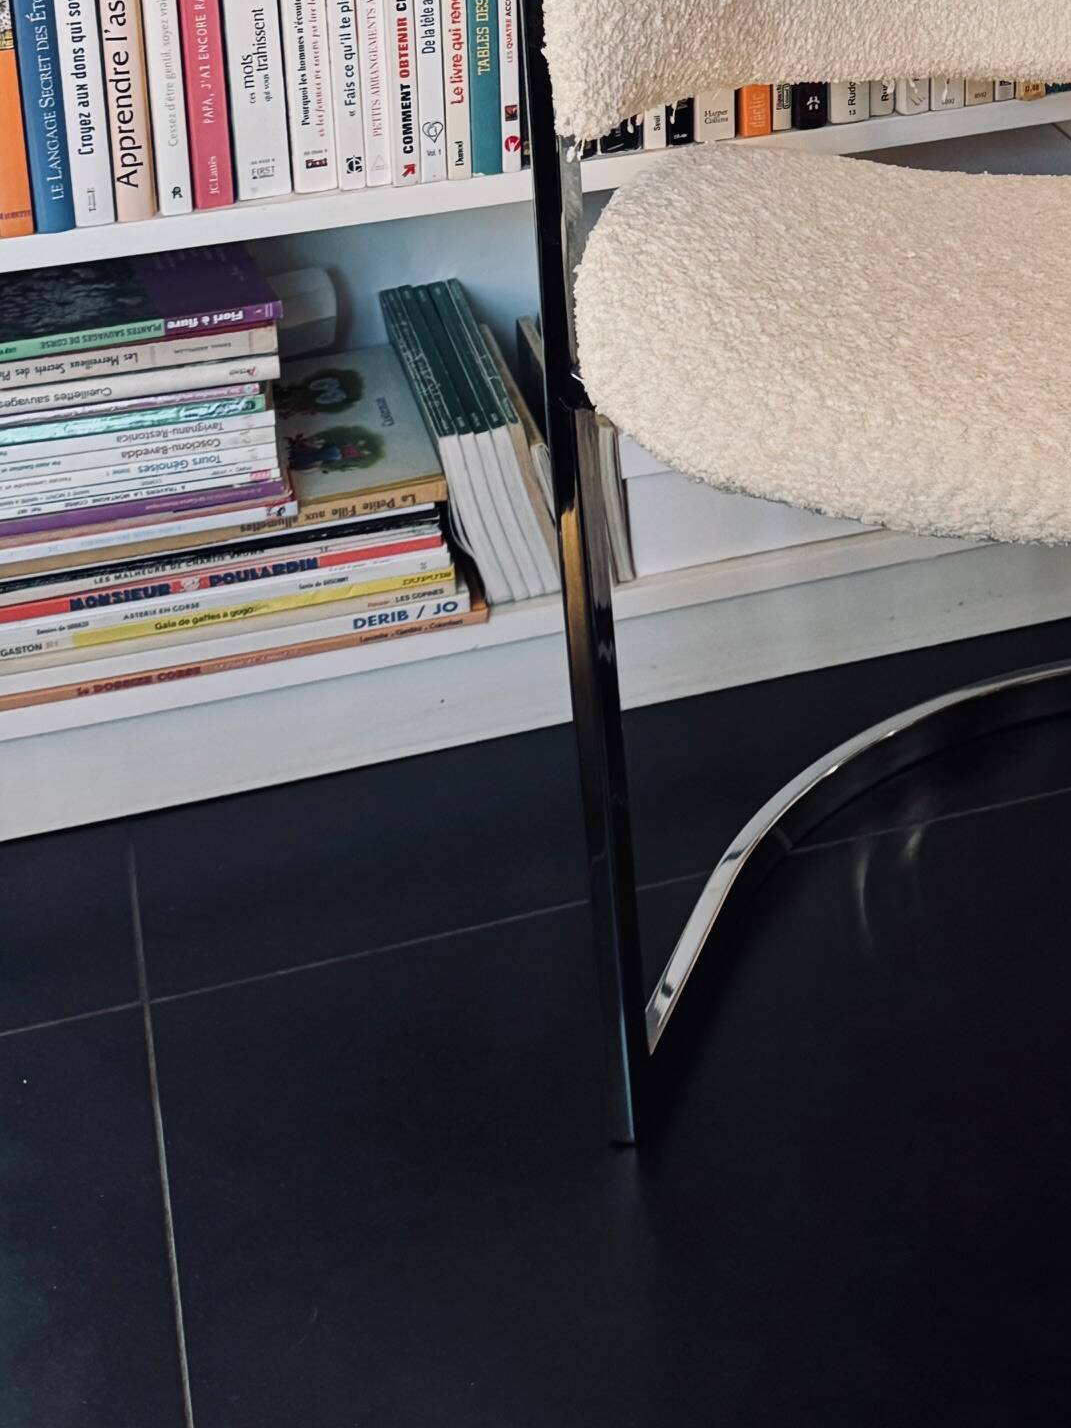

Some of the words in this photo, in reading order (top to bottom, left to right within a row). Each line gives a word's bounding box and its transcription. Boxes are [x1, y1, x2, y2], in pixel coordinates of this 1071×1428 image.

[68, 22, 88, 43] qui
[396, 17, 410, 78] OBTENIR
[450, 28, 466, 50] qui
[70, 47, 90, 79] dons
[476, 26, 491, 74] TABLES
[449, 55, 463, 84] livre
[73, 83, 91, 107] aux
[451, 88, 464, 104] Le
[76, 112, 96, 155] Croyez
[107, 51, 143, 188] Apprendre
[400, 83, 413, 154] COMMENT
[138, 460, 188, 473] Génoises
[192, 454, 221, 466] Tours
[69, 583, 172, 612] MONSIEUR
[209, 556, 319, 588] POULARDIN
[353, 610, 409, 630] DERIB
[433, 600, 458, 615] JO
